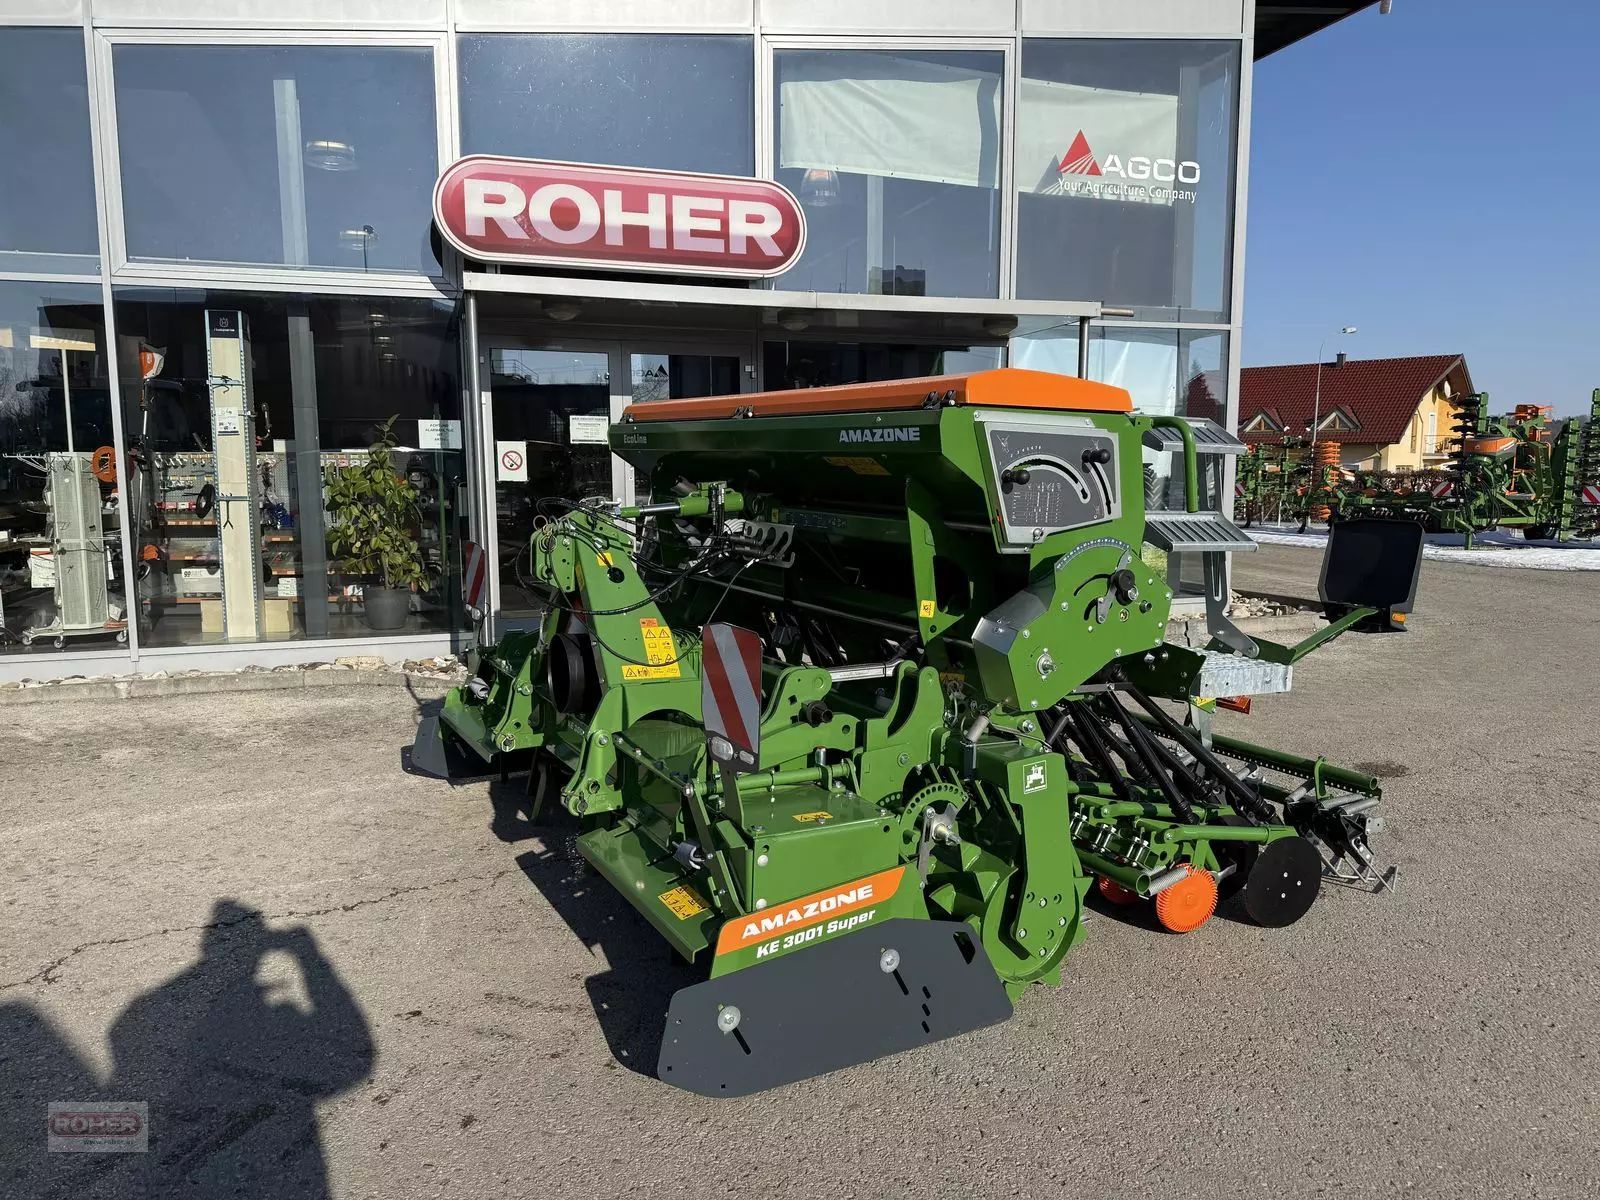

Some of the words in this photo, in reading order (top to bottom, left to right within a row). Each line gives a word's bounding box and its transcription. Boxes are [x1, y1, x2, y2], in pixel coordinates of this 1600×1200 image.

[1102, 154, 1200, 184] AGCO
[1058, 178, 1082, 192] Your
[1085, 181, 1144, 197] Agriculture
[1149, 185, 1196, 203] Company
[463, 178, 784, 257] ROHER
[623, 433, 647, 443] EcoLine
[839, 427, 920, 443] AMAZONE
[742, 884, 873, 939] AMAZONE
[756, 940, 780, 959] KE
[783, 927, 823, 948] 3001
[827, 910, 875, 933] Super
